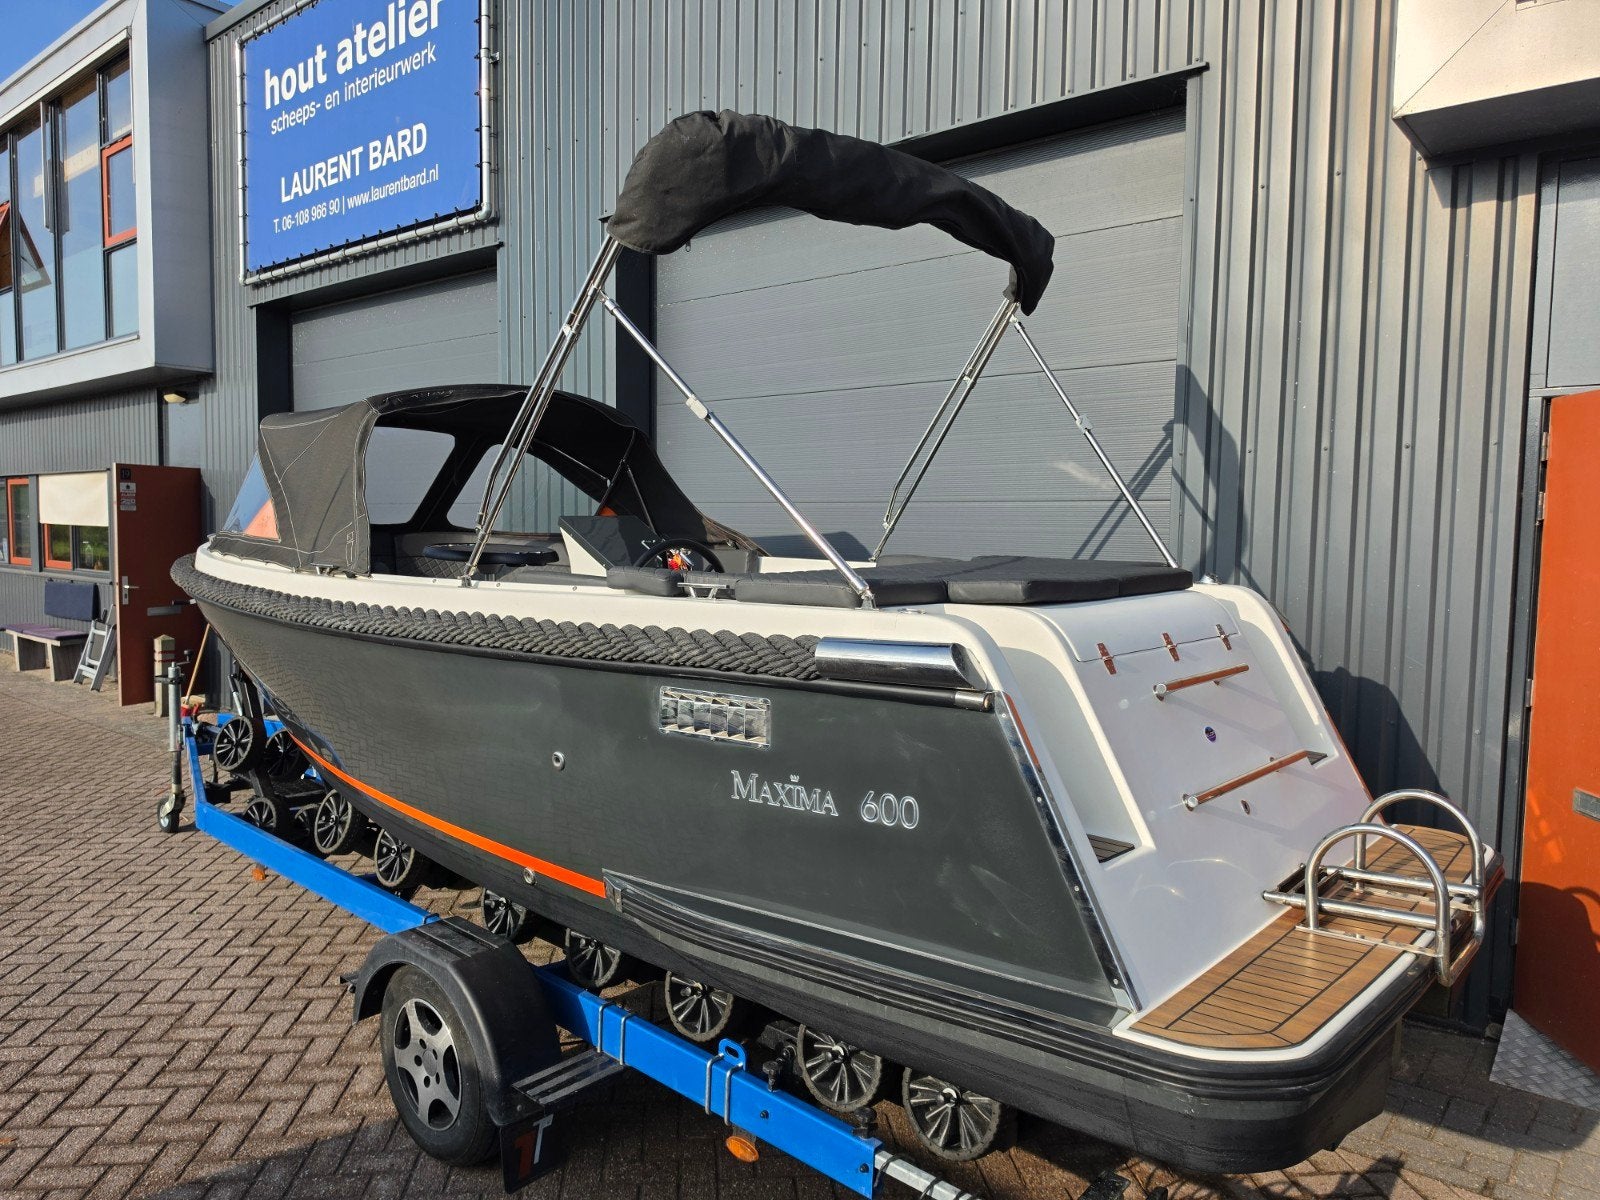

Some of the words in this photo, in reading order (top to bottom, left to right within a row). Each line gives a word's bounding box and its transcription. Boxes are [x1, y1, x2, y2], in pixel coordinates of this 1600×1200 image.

[264, 44, 327, 110] hout
[336, 0, 443, 75] atelier
[271, 101, 321, 135] scheeps-
[325, 90, 340, 111] en
[344, 41, 437, 102] interieurwerk
[273, 218, 281, 234] T.
[281, 208, 310, 230] 06-108
[311, 202, 327, 221] 966
[329, 198, 340, 215] 90
[346, 163, 439, 210] www.laurentbard.nl
[281, 146, 364, 203] LAURENT
[368, 122, 427, 171] BARD
[860, 790, 919, 830] 600
